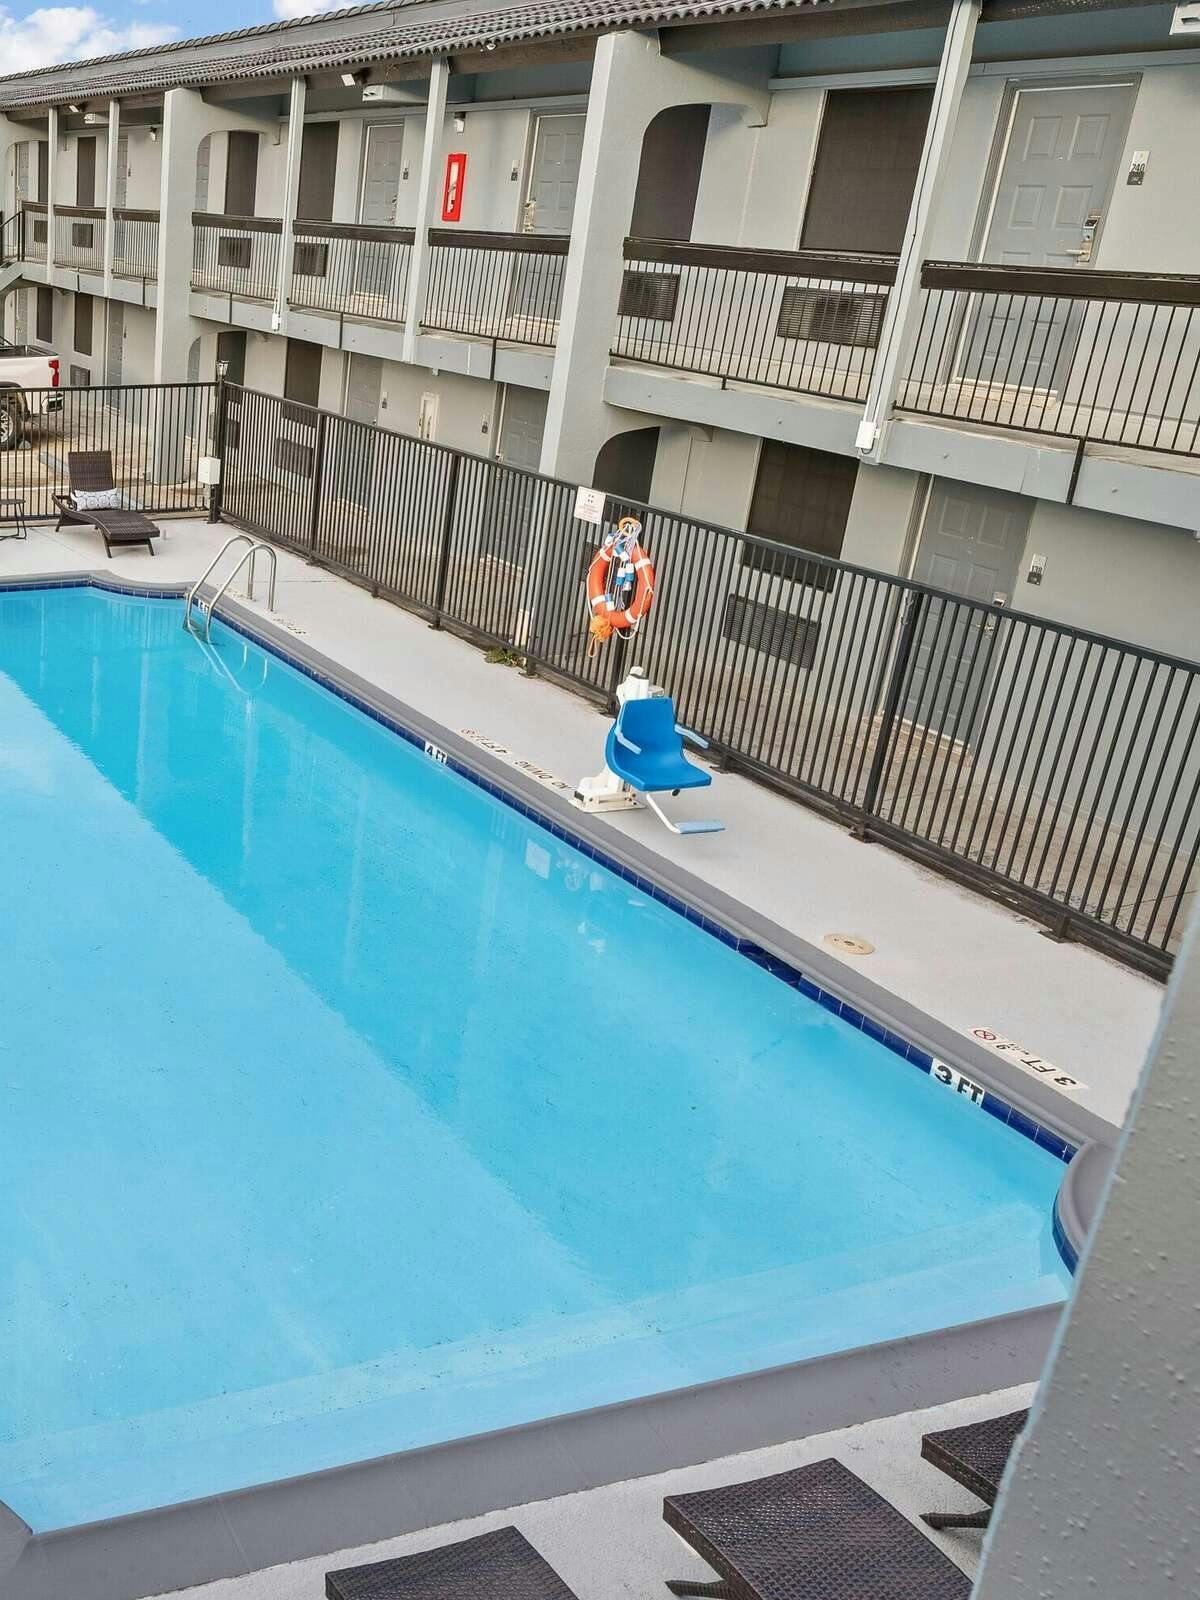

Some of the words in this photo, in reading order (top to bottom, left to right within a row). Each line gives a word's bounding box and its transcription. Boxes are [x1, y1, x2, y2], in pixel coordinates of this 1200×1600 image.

[426, 744, 434, 757] 4
[1020, 1058, 1056, 1073] FT
[934, 1064, 953, 1086] 3
[1054, 1076, 1077, 1087] 3
